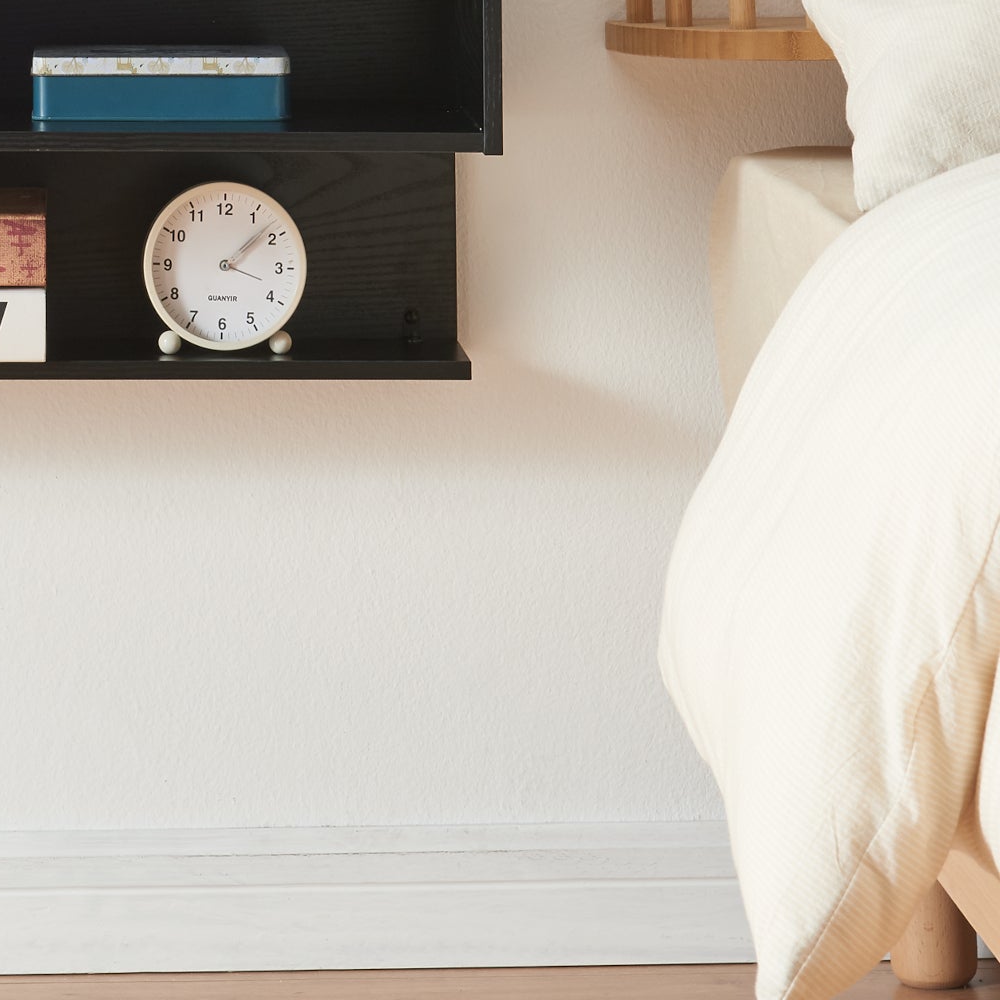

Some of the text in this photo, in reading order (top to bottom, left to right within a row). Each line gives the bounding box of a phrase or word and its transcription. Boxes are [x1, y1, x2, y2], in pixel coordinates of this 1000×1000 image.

[217, 203, 233, 215] 12
[189, 210, 204, 223] 11
[250, 212, 256, 224] 1
[170, 229, 186, 243] 10
[268, 233, 277, 246] 2
[163, 259, 173, 271] 9
[275, 262, 284, 275] 3
[170, 287, 179, 300] 8
[266, 290, 275, 303] 4
[190, 310, 199, 323] 7
[246, 312, 255, 325] 5
[218, 318, 227, 331] 6
